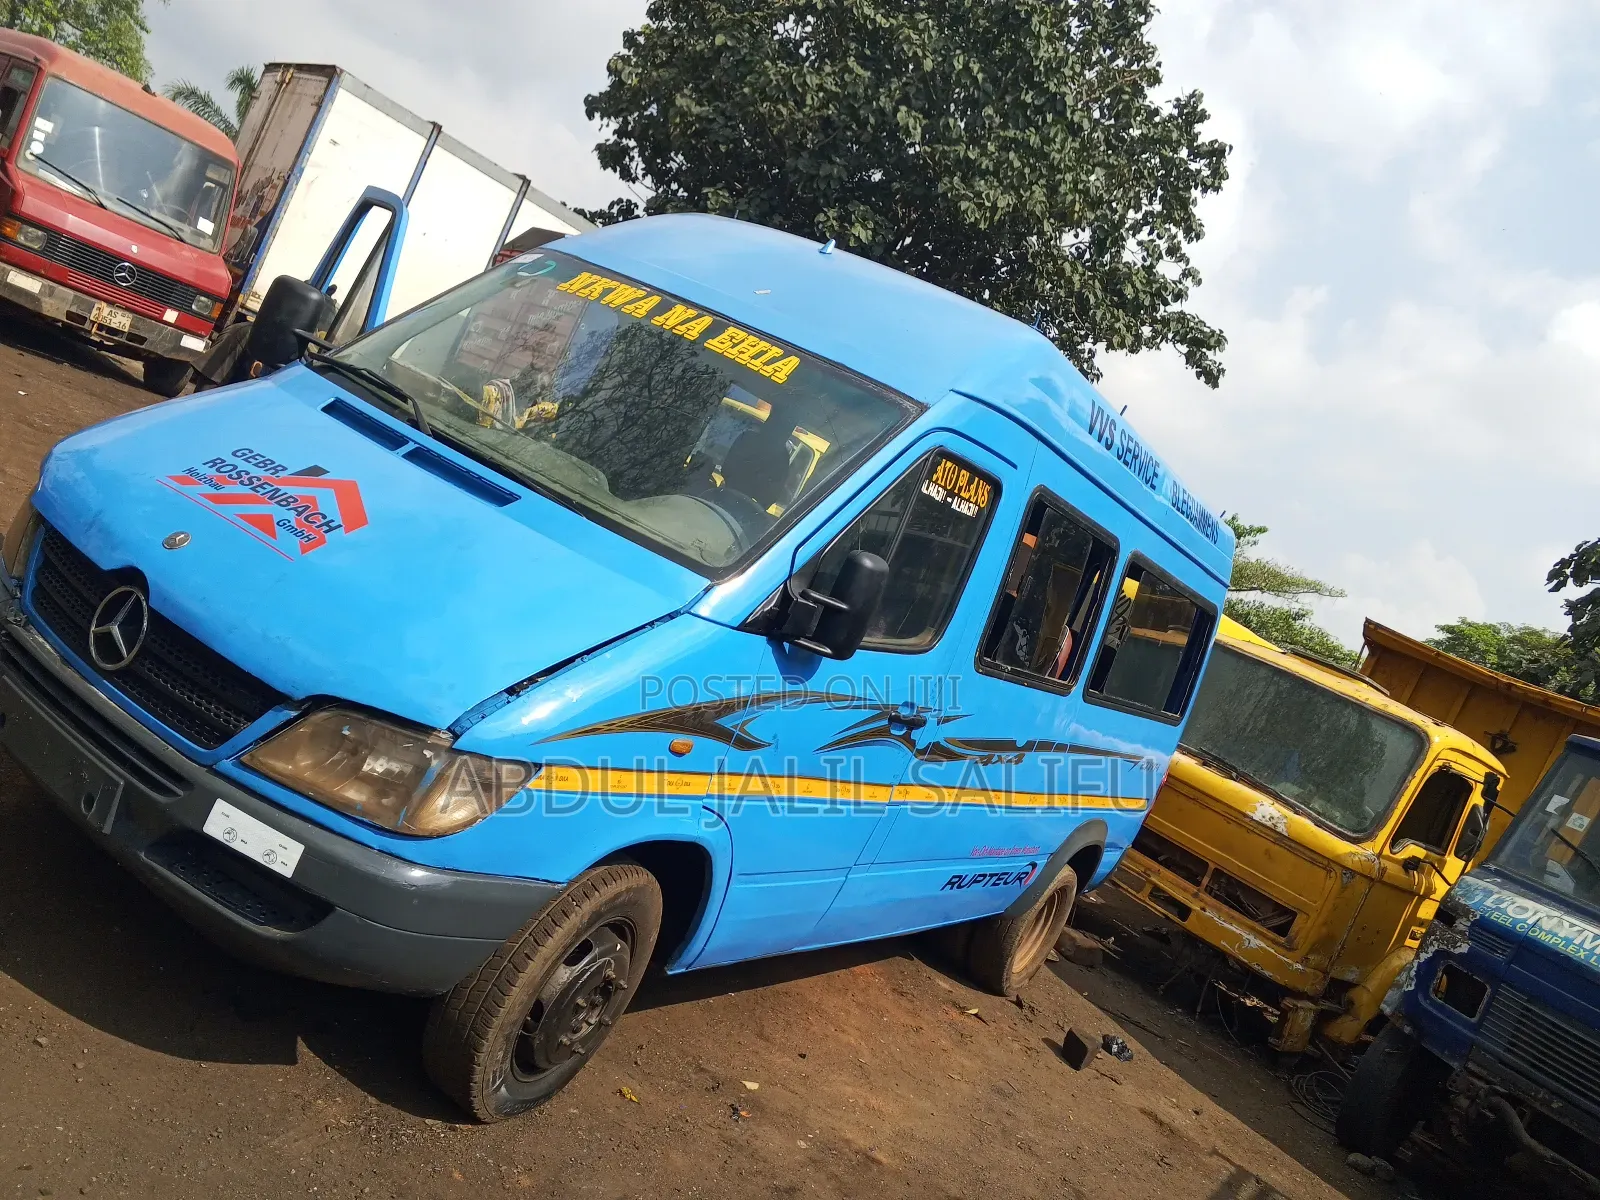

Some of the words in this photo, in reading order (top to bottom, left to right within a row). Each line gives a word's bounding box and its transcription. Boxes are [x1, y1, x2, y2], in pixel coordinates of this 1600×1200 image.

[107, 309, 119, 319] AS
[556, 271, 662, 318] NKWA
[651, 304, 713, 341] NA
[704, 326, 800, 384] EHIA
[1088, 399, 1117, 451] VVS
[1116, 428, 1160, 490] SERVICE
[230, 448, 288, 478] GEBR.
[182, 466, 226, 491] Holzbau
[202, 456, 343, 534] ROSSENBACH
[276, 518, 317, 543] GmbH
[940, 870, 1030, 891] RUPTEUR
[1515, 923, 1588, 959] COMPLEX
